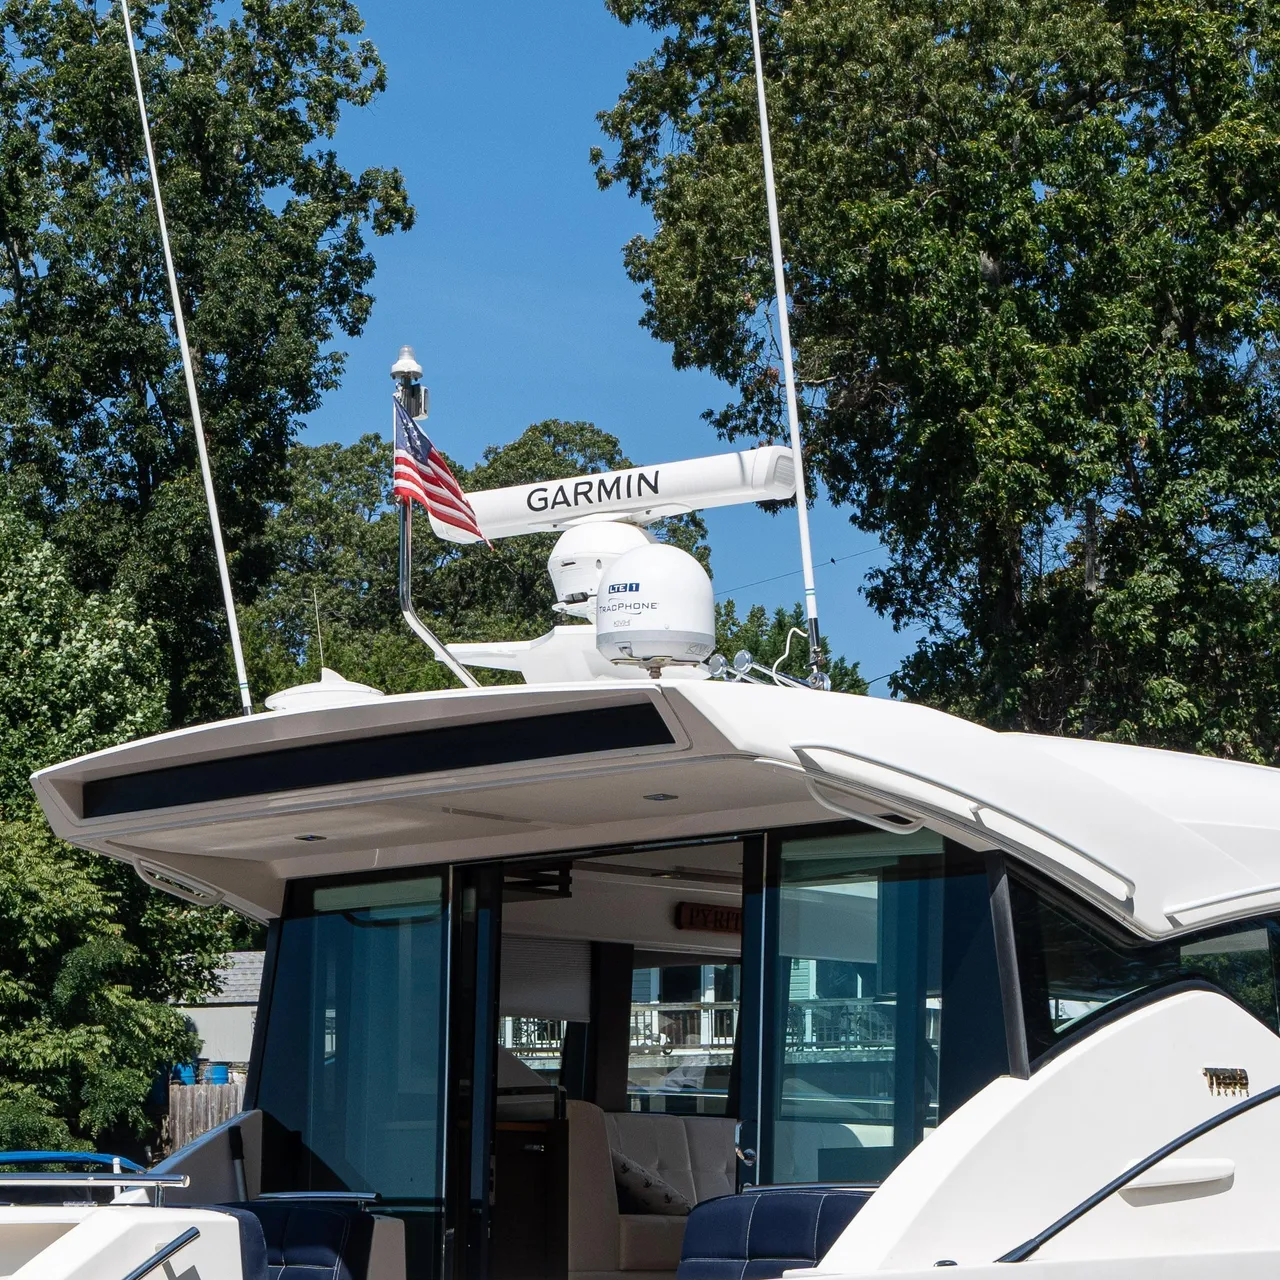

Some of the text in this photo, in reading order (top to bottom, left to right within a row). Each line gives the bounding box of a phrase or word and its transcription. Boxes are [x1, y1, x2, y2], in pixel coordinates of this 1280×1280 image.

[526, 470, 659, 512] GARMIN
[609, 585, 627, 594] LTE
[689, 907, 742, 931] PYRIT
